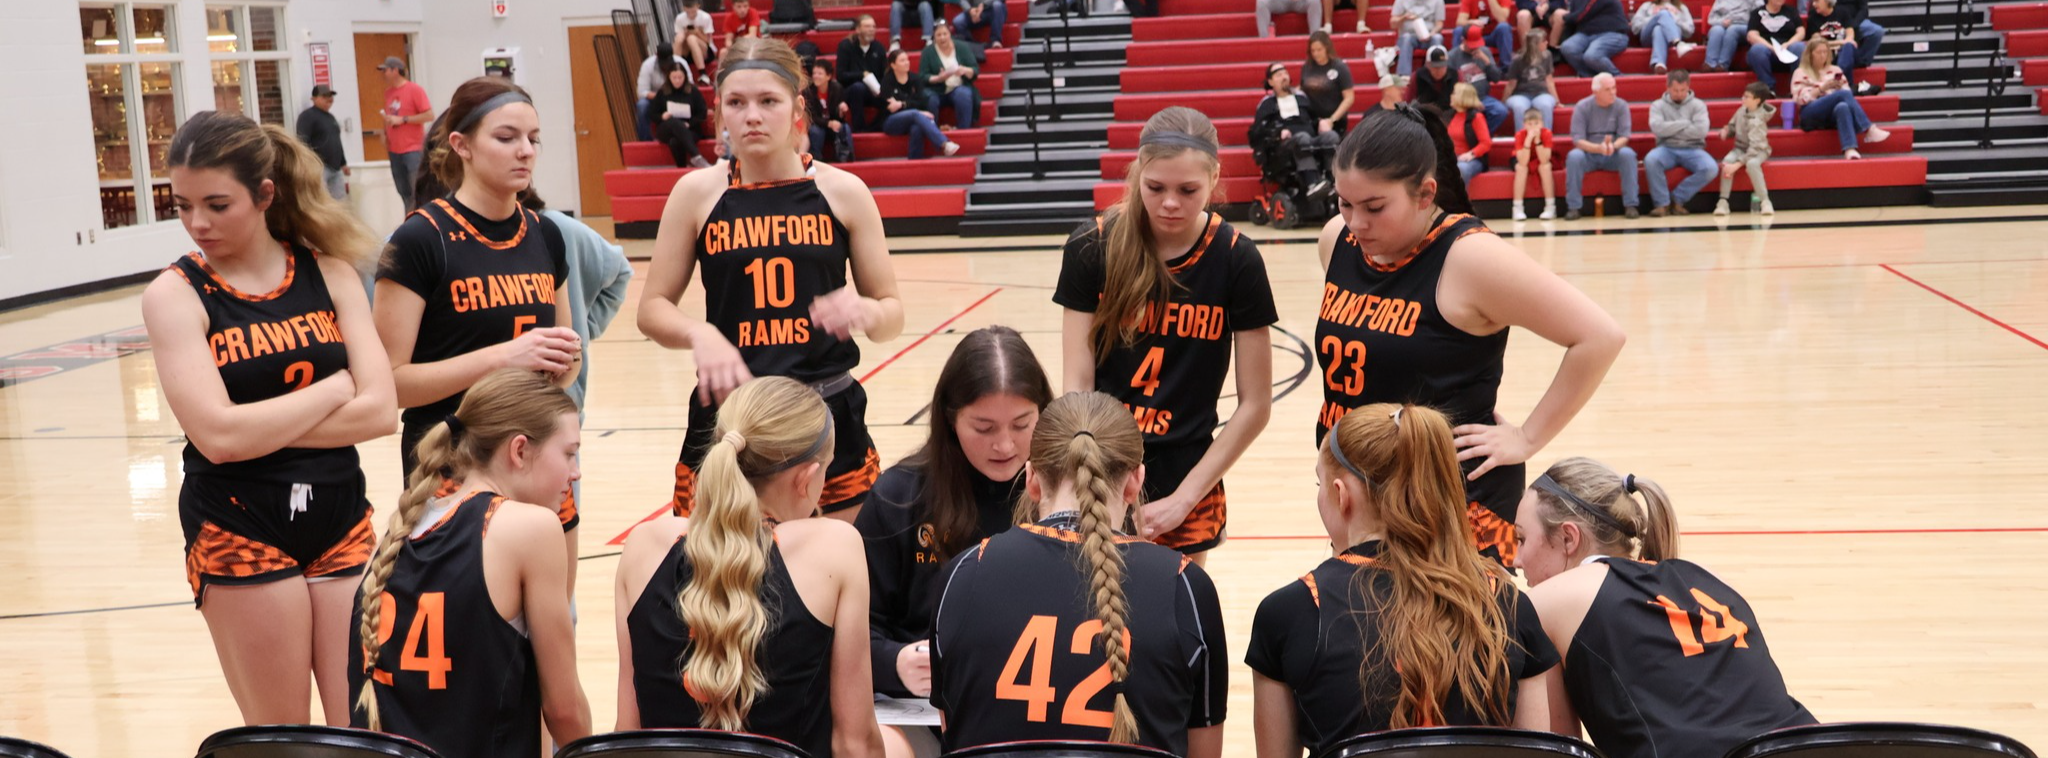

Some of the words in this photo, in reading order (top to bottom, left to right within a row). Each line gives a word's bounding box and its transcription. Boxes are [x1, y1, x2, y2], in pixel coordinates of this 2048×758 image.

[705, 213, 834, 256] CRAWFORD
[744, 256, 795, 310] 10
[1320, 281, 1422, 337] RAWFORD
[738, 317, 810, 348] RAMS
[1130, 346, 1165, 397] 4
[1321, 334, 1367, 397] 23
[1124, 402, 1173, 436] MS
[363, 590, 452, 690] 24
[1646, 587, 1749, 658] 14
[995, 614, 1132, 729] 42
